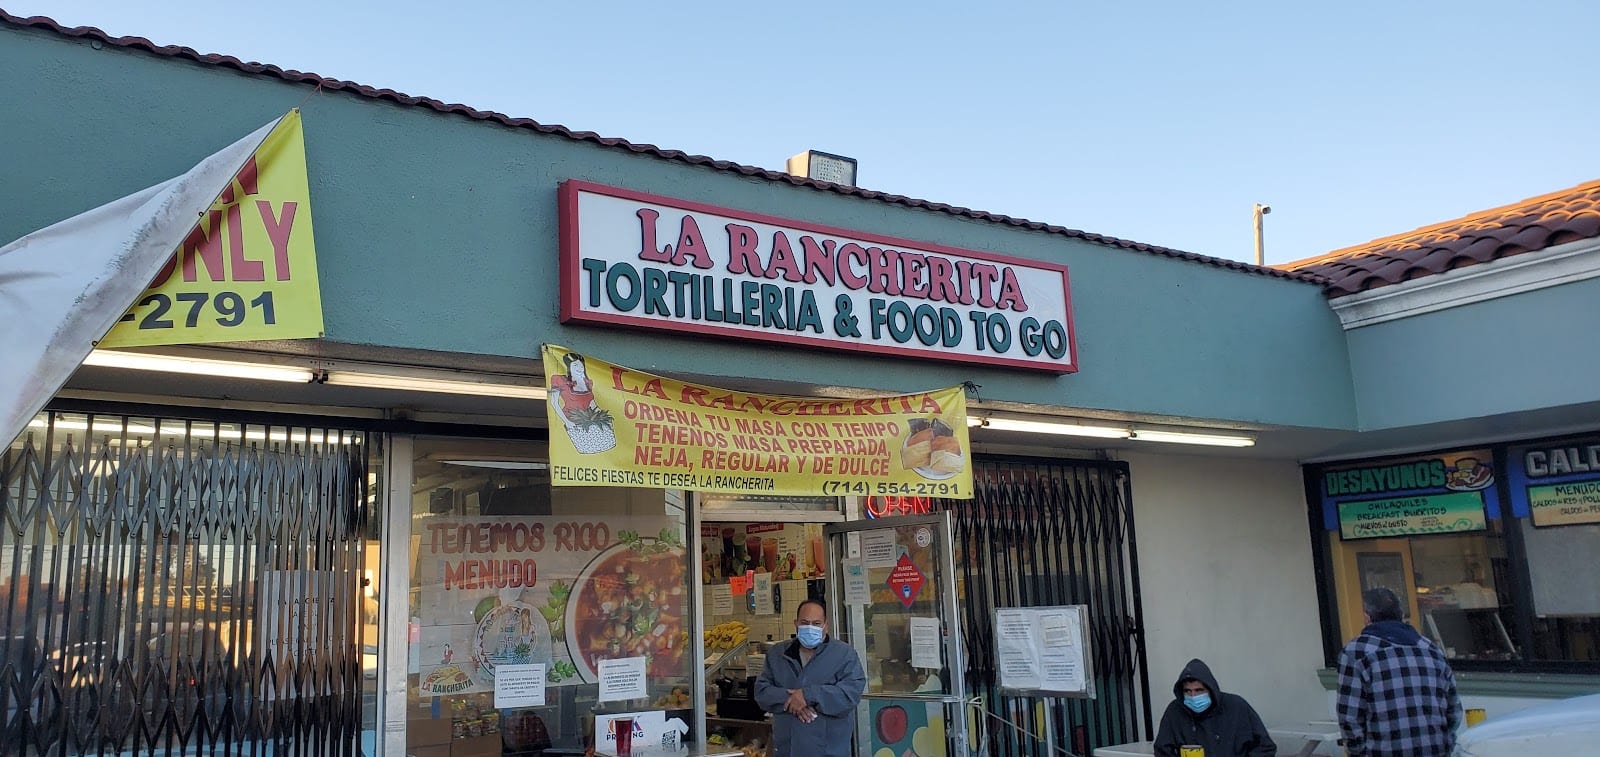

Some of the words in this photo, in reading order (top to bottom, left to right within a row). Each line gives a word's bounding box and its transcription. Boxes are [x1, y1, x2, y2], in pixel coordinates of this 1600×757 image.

[636, 207, 715, 269] LA
[724, 222, 1029, 312] RANCHERITA
[582, 257, 825, 334] TORTILLERIA
[833, 293, 862, 338] &
[869, 298, 963, 348] FOOD
[969, 310, 1012, 354] TO
[1019, 316, 1067, 360] GO
[609, 366, 672, 400] LA
[679, 385, 943, 417] RANCHERITA
[623, 399, 703, 428] ORDENA
[705, 414, 731, 432] TU
[734, 418, 788, 437] MASA
[791, 421, 830, 438] CON
[832, 421, 900, 438] TIEMPO
[634, 445, 694, 473] NEJA,
[701, 449, 790, 473] REGULAR
[796, 455, 808, 474] Y
[812, 456, 834, 475] DE
[838, 456, 890, 477] DULCE
[732, 434, 785, 454] MASA
[790, 438, 892, 460] PREPARADA,
[553, 465, 598, 482] FELICES
[601, 469, 645, 485] FIESTAS
[648, 471, 660, 486] TE
[663, 472, 697, 487] DESEA
[700, 474, 713, 488] LA
[714, 475, 774, 491] RANCHERITA
[822, 480, 870, 496] (714)
[877, 481, 959, 495] 554-2791
[1325, 459, 1446, 496] DESAYUNOS
[1356, 510, 1401, 521] BREAKFAST
[1403, 507, 1447, 517] BURRITOS
[1367, 498, 1428, 510] CHILAQUILES
[426, 521, 546, 554] TENEMOS
[552, 521, 611, 552] RICO
[444, 558, 537, 591] MENUDO
[432, 679, 474, 693] RANCHERITA
